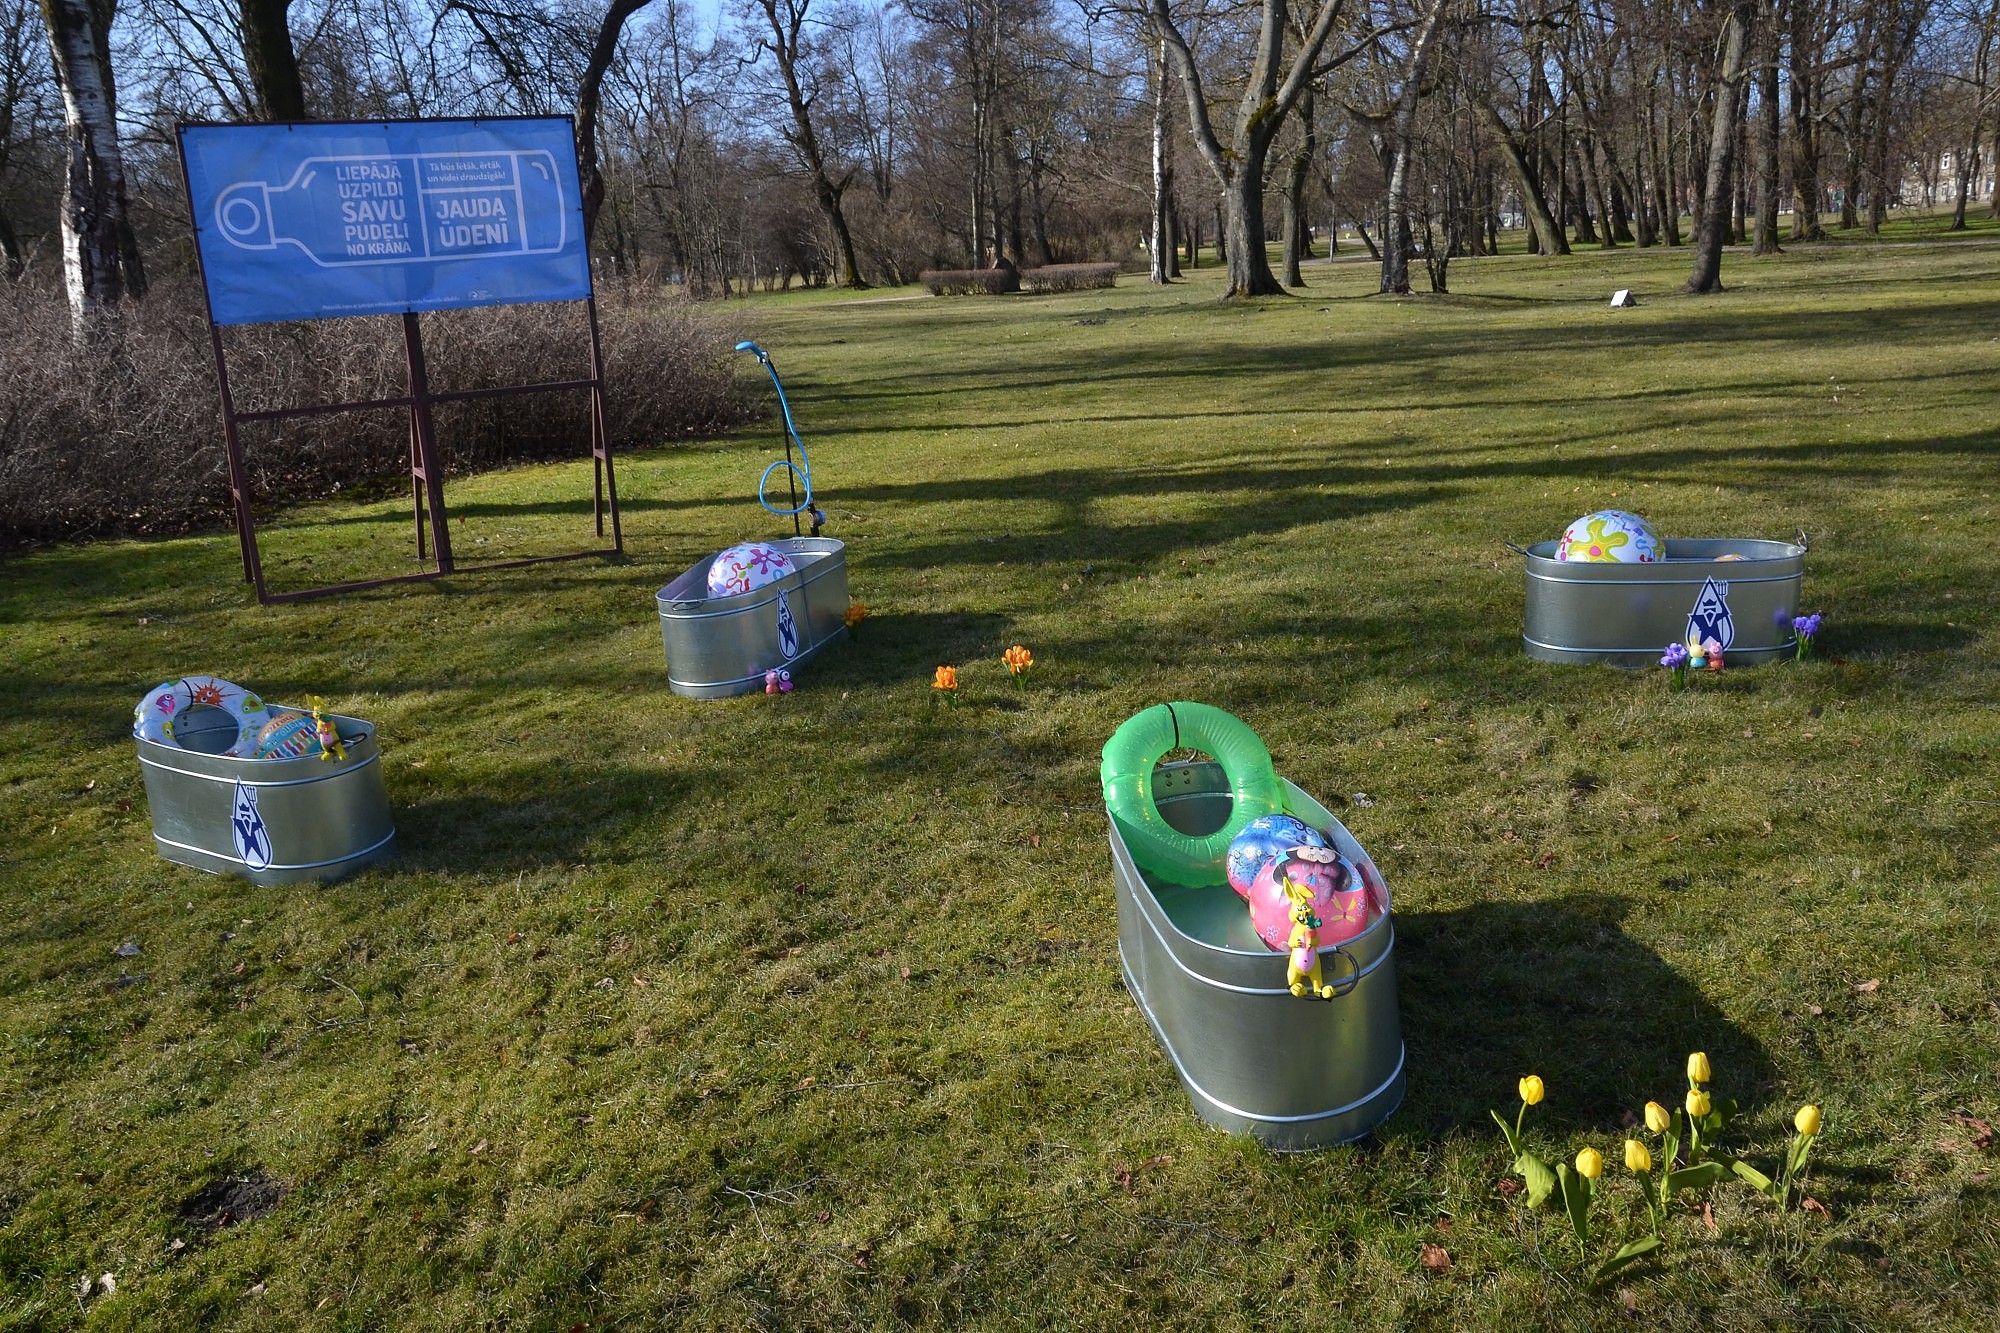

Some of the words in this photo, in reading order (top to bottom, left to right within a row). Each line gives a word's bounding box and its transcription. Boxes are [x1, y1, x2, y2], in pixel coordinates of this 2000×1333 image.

[336, 161, 402, 181] LIEPĀJĀ
[427, 173, 439, 183] un
[440, 172, 459, 182] videi
[338, 181, 403, 199] UZPILDI
[342, 199, 406, 223] SAVU
[436, 197, 507, 219] JAUDA
[344, 222, 409, 241] PUDELI
[440, 217, 509, 247] ŪDENĪ
[346, 244, 366, 256] NO
[368, 239, 412, 255] KRĀNA
